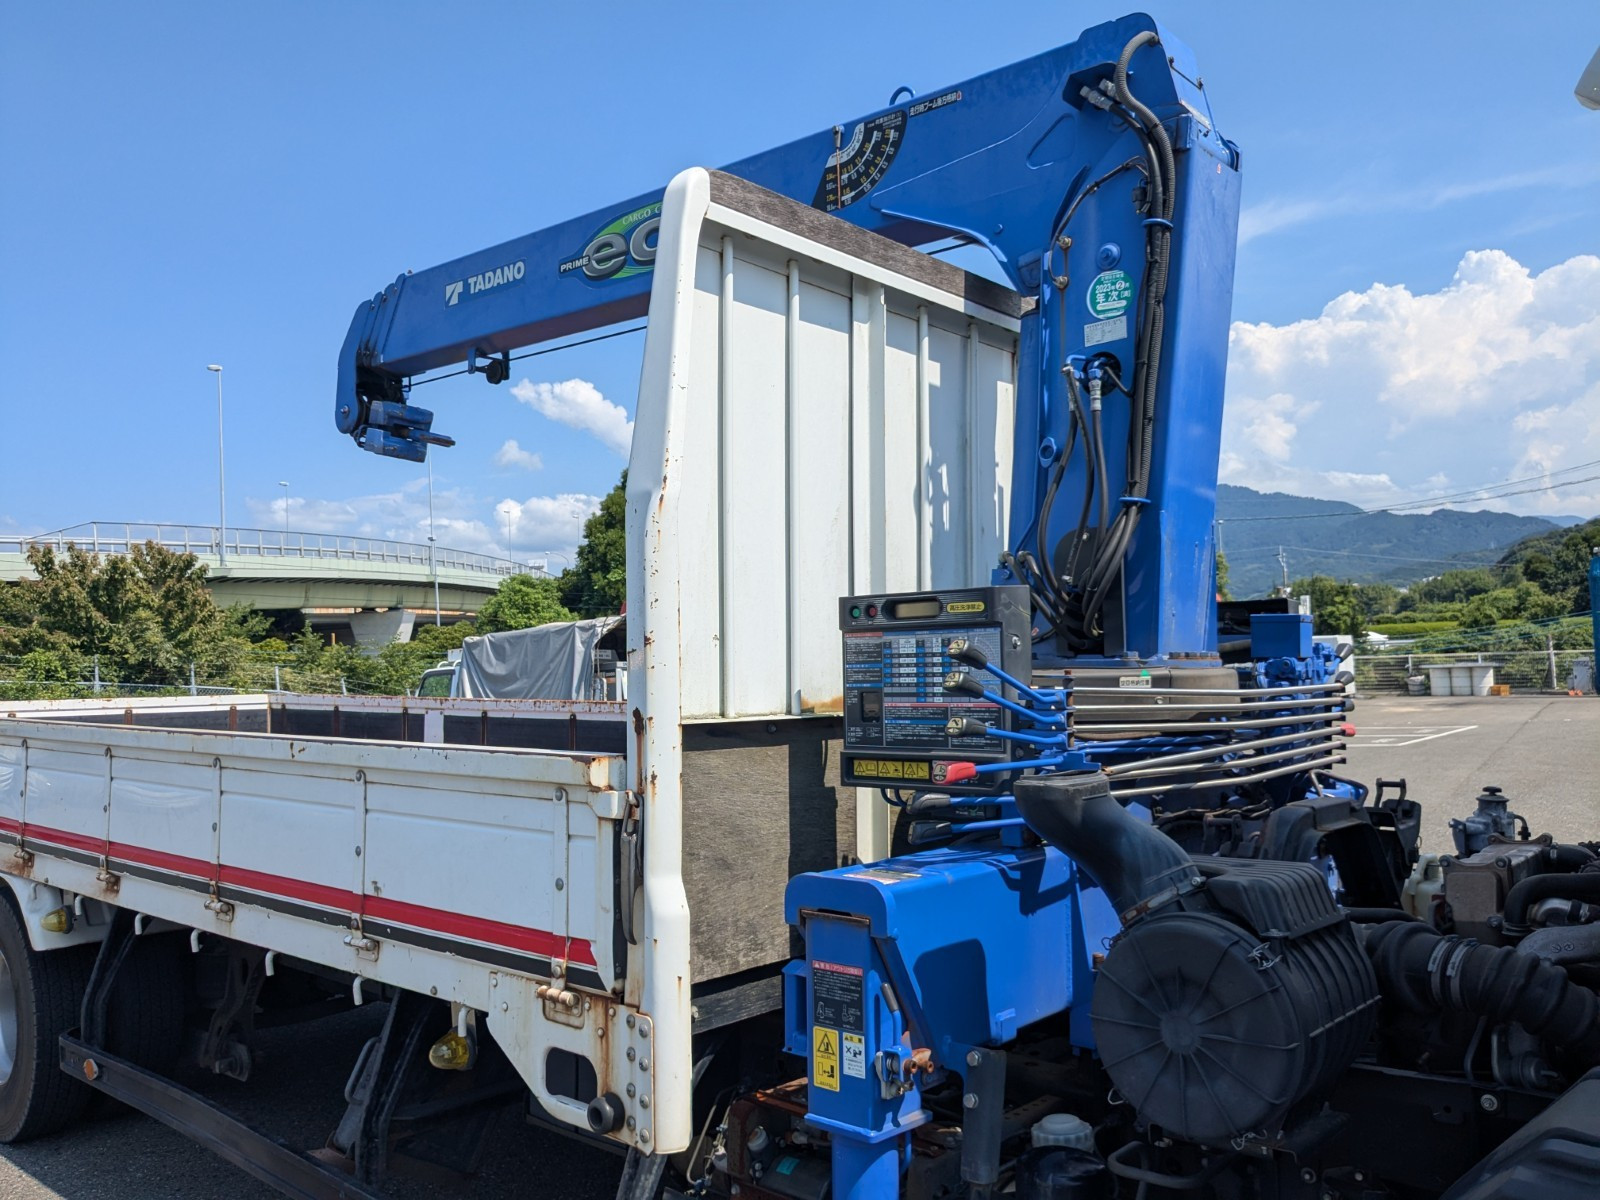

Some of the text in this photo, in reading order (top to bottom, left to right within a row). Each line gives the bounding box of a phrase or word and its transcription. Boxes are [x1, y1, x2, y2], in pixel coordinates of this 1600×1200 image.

[622, 208, 651, 225] CARGO
[560, 256, 589, 273] PRIME
[468, 261, 525, 294] TADANO
